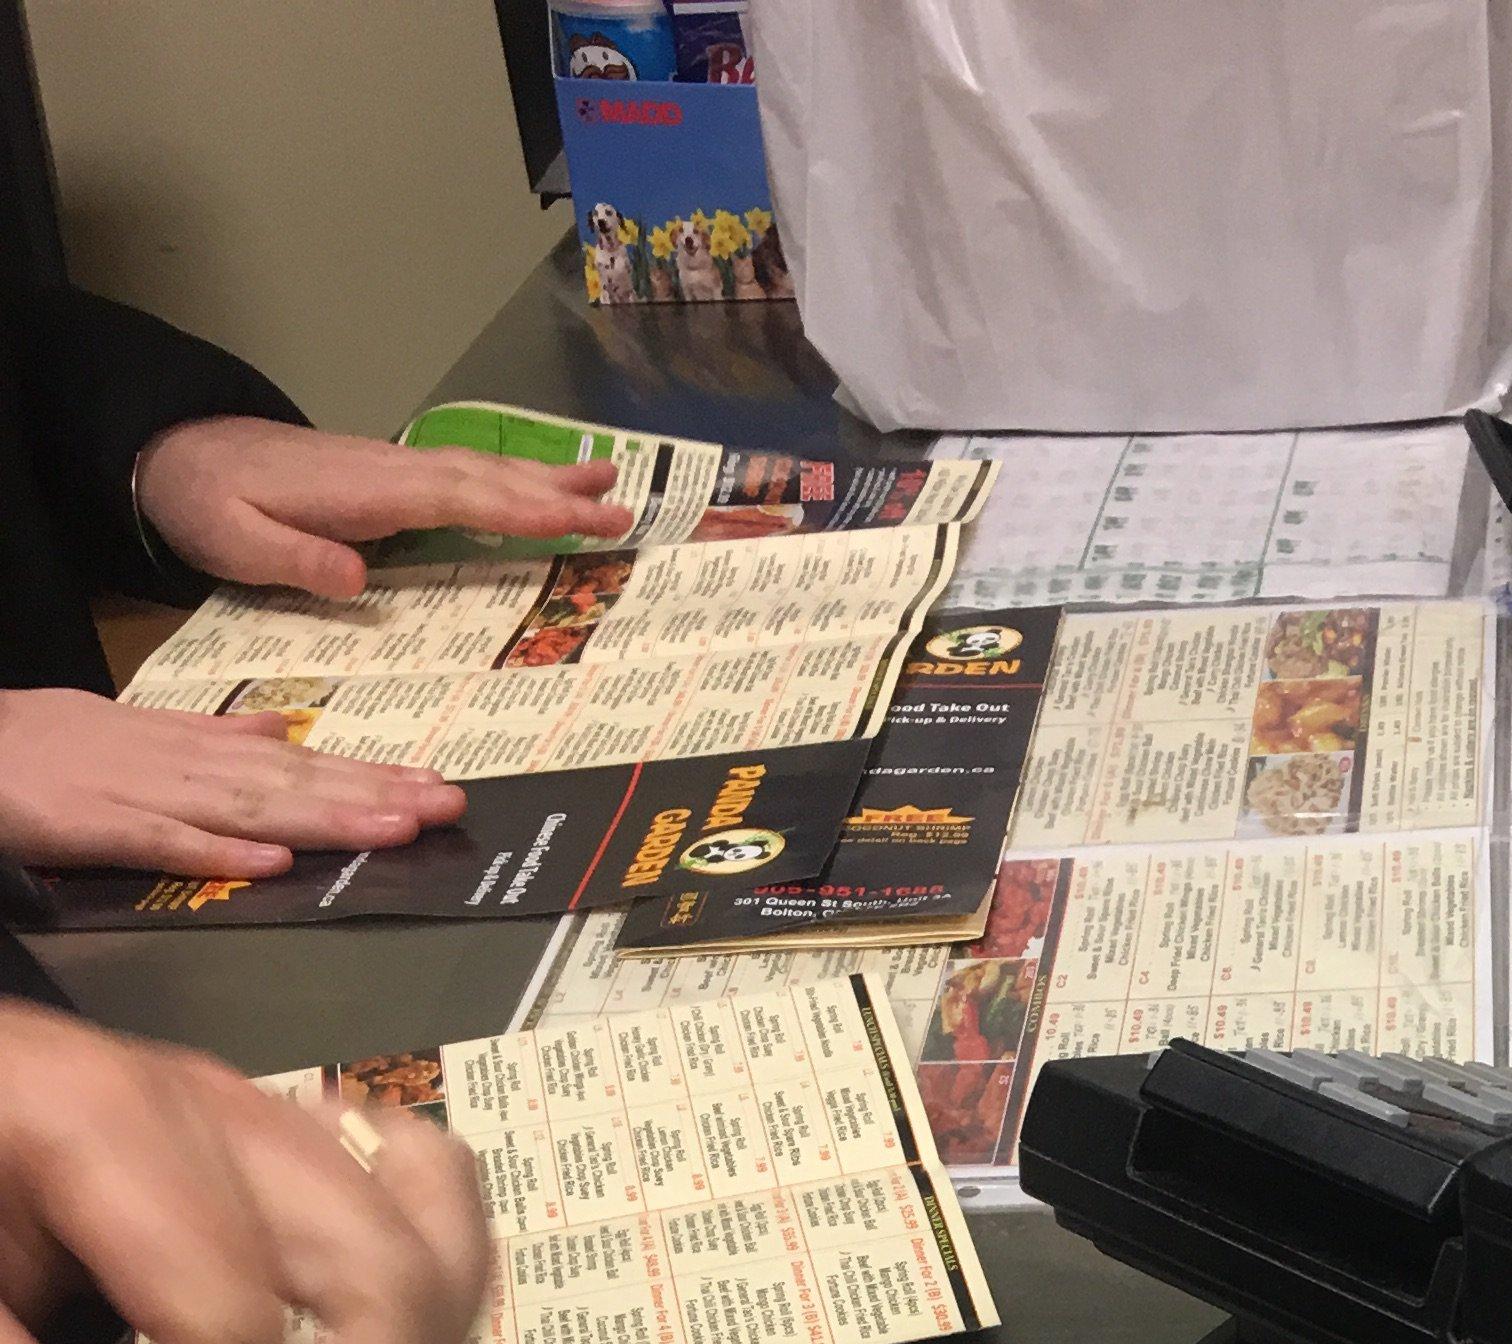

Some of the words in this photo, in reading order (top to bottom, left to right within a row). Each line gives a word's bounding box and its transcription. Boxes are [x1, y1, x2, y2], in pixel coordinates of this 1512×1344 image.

[906, 660, 1020, 675] RDEN
[930, 703, 971, 712] Take
[976, 703, 1010, 712] Out
[950, 716, 1007, 724] Delivery
[702, 764, 767, 830] PANDA
[622, 808, 692, 888] GARDEN
[766, 897, 816, 906] Queen
[820, 899, 837, 907] St
[761, 908, 816, 917] Bolton,
[1118, 932, 1132, 965] Chicken
[1127, 888, 1140, 907] Rice
[1055, 974, 1068, 988] C2
[1024, 971, 1048, 1034] COMBOS
[1045, 1012, 1059, 1040] 10.49
[1128, 1008, 1143, 1043] $10.49
[1213, 1004, 1227, 1039] $10.49
[868, 1034, 889, 1069] SPECIALS
[832, 1109, 843, 1125] Fried
[836, 1125, 847, 1141] Rice
[923, 1195, 944, 1228] DINNER
[934, 1228, 958, 1271] SPECIALS
[910, 1237, 927, 1264] Dinner
[839, 1256, 852, 1270] Thai
[855, 1254, 871, 1269] Beef
[790, 1260, 806, 1286] Dinner
[861, 1269, 875, 1283] with
[894, 1260, 909, 1282] Spring
[902, 1281, 915, 1295] Roll
[919, 1265, 932, 1279] For
[649, 1283, 663, 1308] Dinner
[771, 1281, 786, 1302] Spring
[798, 1287, 811, 1302] For
[826, 1274, 840, 1298] Fortune
[846, 1283, 861, 1308] Chicken
[865, 1283, 880, 1302] Mixed
[878, 1266, 892, 1288] Mango
[885, 1288, 900, 1314] Chicken
[924, 1287, 942, 1301] (B)
[655, 1309, 668, 1323] For
[777, 1301, 792, 1316] Roll
[801, 1310, 819, 1324] (B)
[832, 1298, 848, 1326] Cookies
[854, 1307, 868, 1325] Fried
[870, 1302, 888, 1334] Vegetable
[931, 1303, 952, 1331] $30.99
[656, 1331, 674, 1344] (B)
[858, 1324, 872, 1339] Rice
